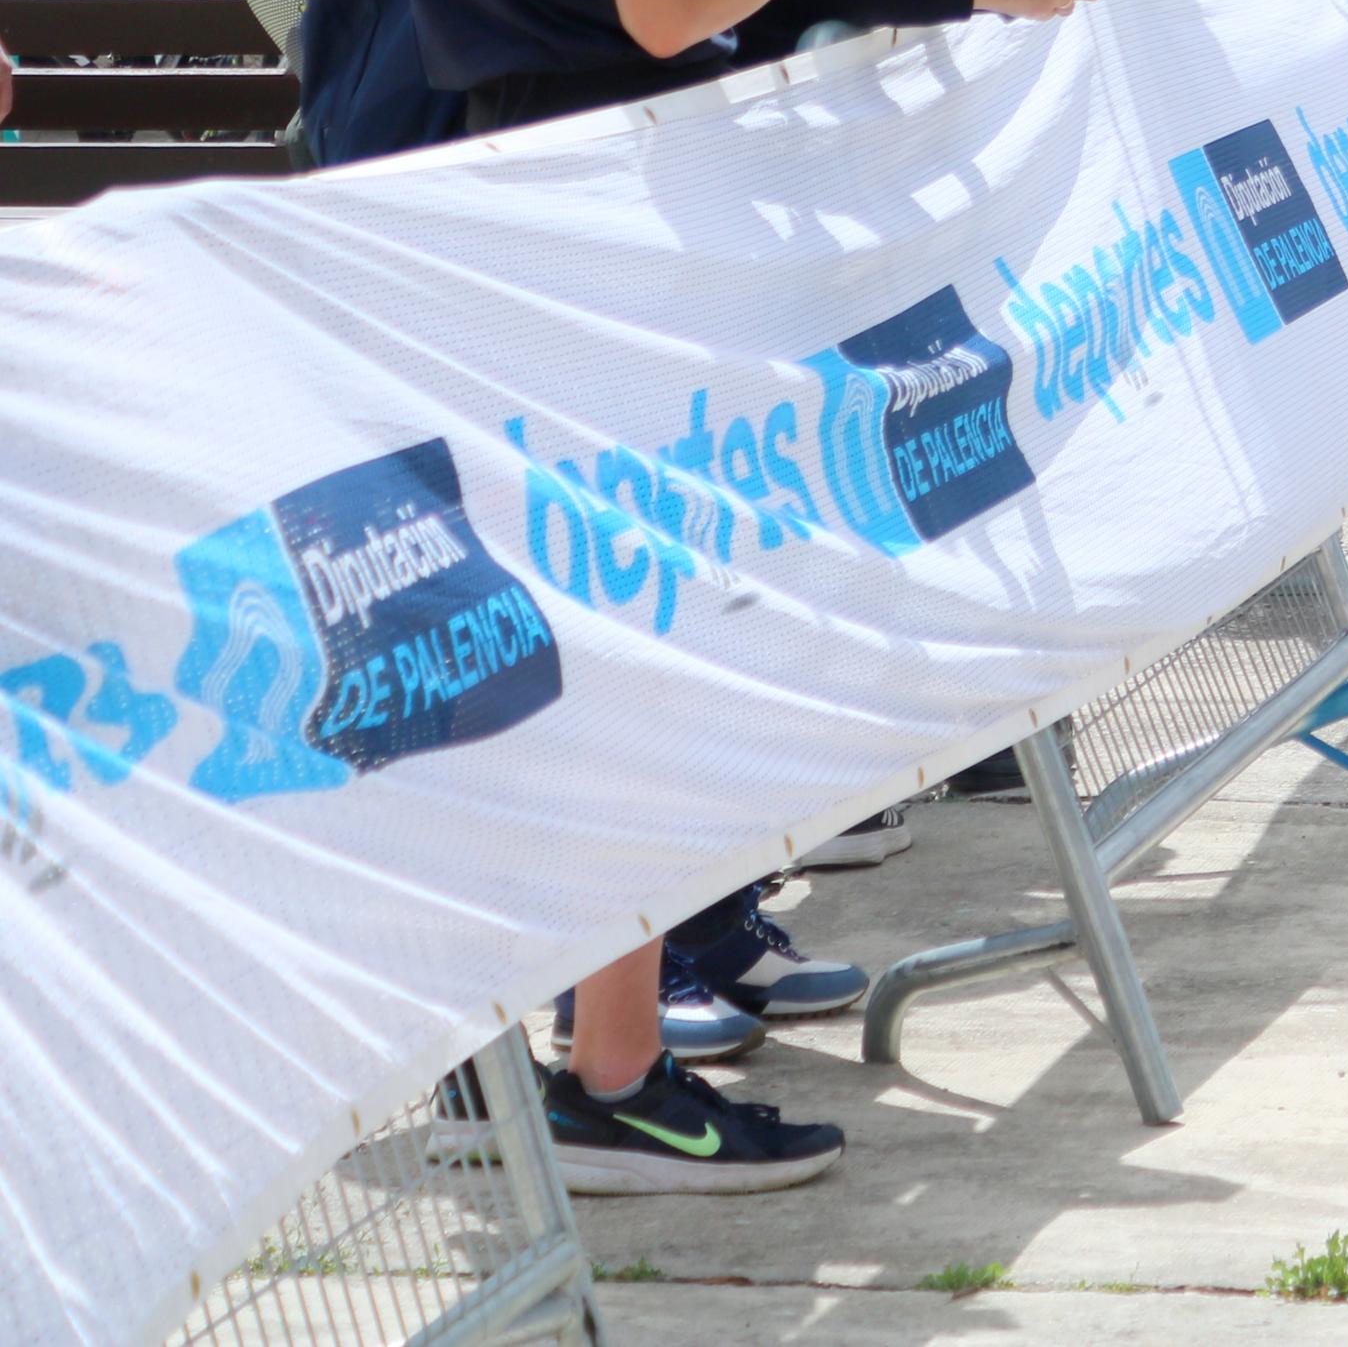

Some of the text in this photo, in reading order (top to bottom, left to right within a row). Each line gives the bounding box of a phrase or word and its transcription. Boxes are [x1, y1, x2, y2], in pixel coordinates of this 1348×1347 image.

[1253, 218, 1335, 291] DE PALENCIA
[893, 395, 1013, 503] DE PALENCIA
[301, 503, 467, 629] Diputación
[319, 585, 550, 740] DE PALENCIA
